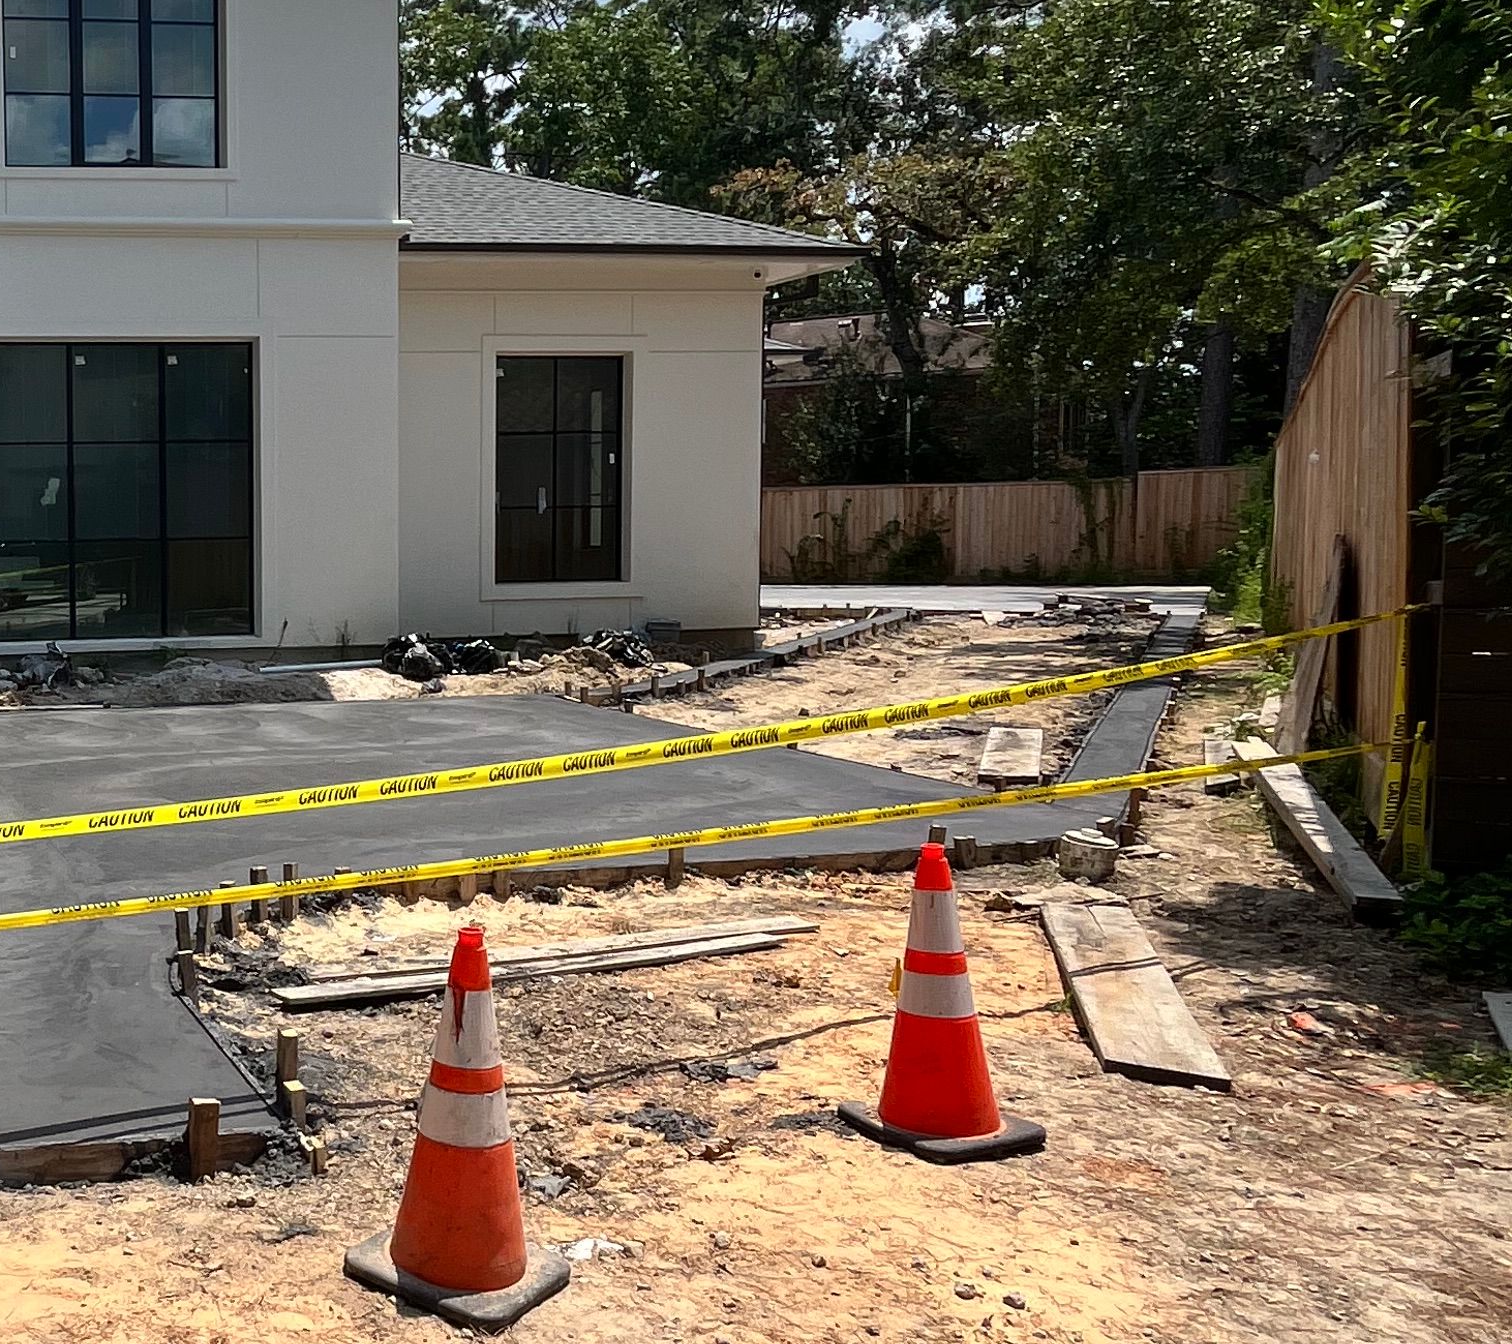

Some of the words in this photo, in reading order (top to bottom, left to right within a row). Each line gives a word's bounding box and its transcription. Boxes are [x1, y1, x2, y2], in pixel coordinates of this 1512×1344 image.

[88, 810, 154, 828] CAUTION
[179, 800, 242, 819] CAUTION
[299, 785, 360, 805] CAUTION
[380, 775, 439, 795] CAUTION
[489, 761, 544, 782] CAUTION
[563, 751, 616, 772] CAUTION
[663, 738, 713, 758] CAUTION
[730, 728, 779, 748] CAUTION
[822, 713, 869, 734] CAUTION
[884, 703, 929, 724] CAUTION
[968, 689, 1011, 709] CAUTION
[1026, 679, 1068, 698] CAUTION
[1383, 781, 1400, 831] CAUTION
